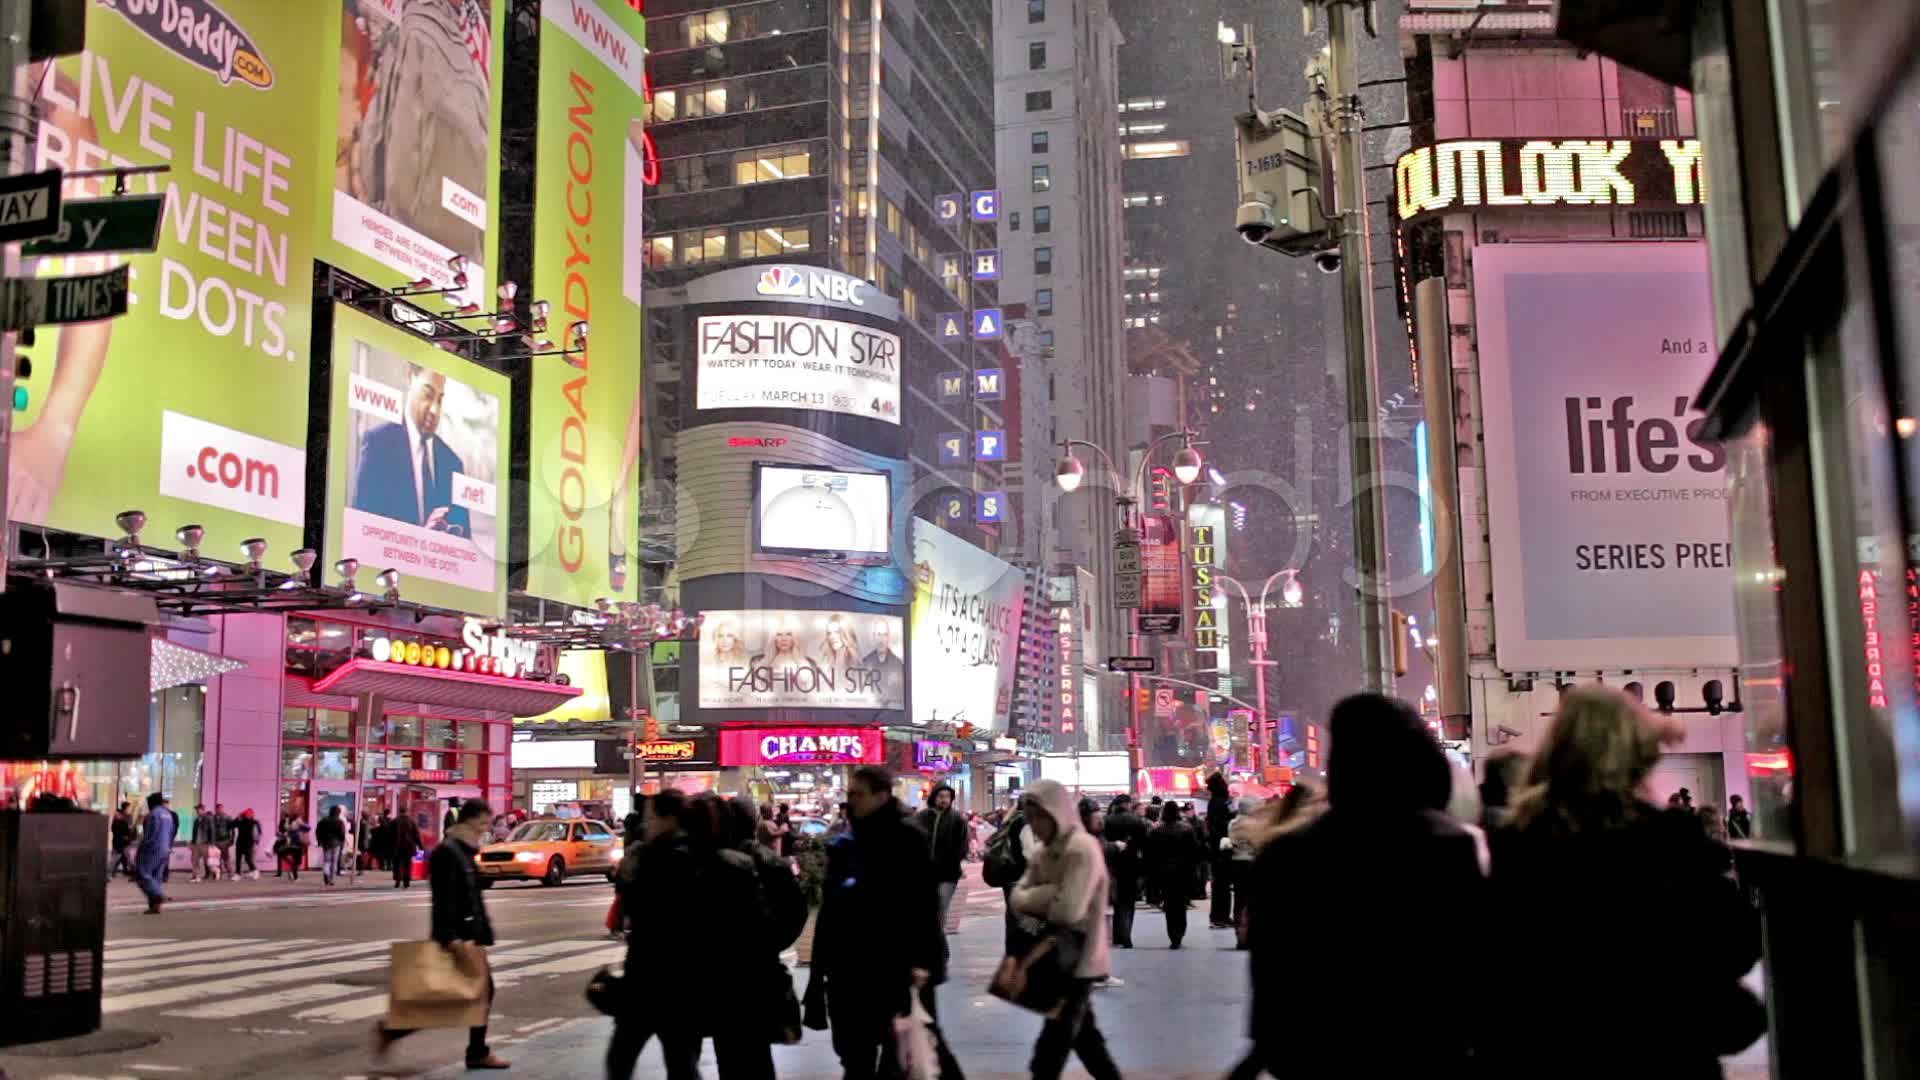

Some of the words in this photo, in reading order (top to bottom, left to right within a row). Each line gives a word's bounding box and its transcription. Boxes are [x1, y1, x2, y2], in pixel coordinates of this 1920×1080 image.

[40, 50, 174, 162] LIVE
[193, 111, 292, 217] LIFE
[0, 192, 38, 223] AY
[53, 276, 113, 319] TIMES
[808, 271, 865, 306] NBC
[159, 258, 297, 362] DOTS.
[703, 320, 838, 358] FASHION
[850, 331, 896, 371] STAR
[1660, 337, 1692, 354] And
[1698, 339, 1708, 353] a
[707, 358, 745, 369] WATCH
[749, 358, 760, 369] IT
[802, 361, 831, 372] WEAR
[761, 390, 808, 404] MARCH
[810, 392, 825, 404] 13
[727, 437, 788, 449] SHARP
[1564, 396, 1728, 474] life's
[186, 446, 280, 499] .com
[460, 486, 485, 498] .net
[1570, 490, 1611, 502] FROM
[1615, 488, 1689, 501] EXECUTIVE
[1575, 543, 1666, 570] SERIES
[728, 666, 835, 693] FASHION
[844, 667, 883, 694] STAR
[1058, 606, 1074, 734] AMSTERDAM
[760, 734, 864, 760] CHAMPS
